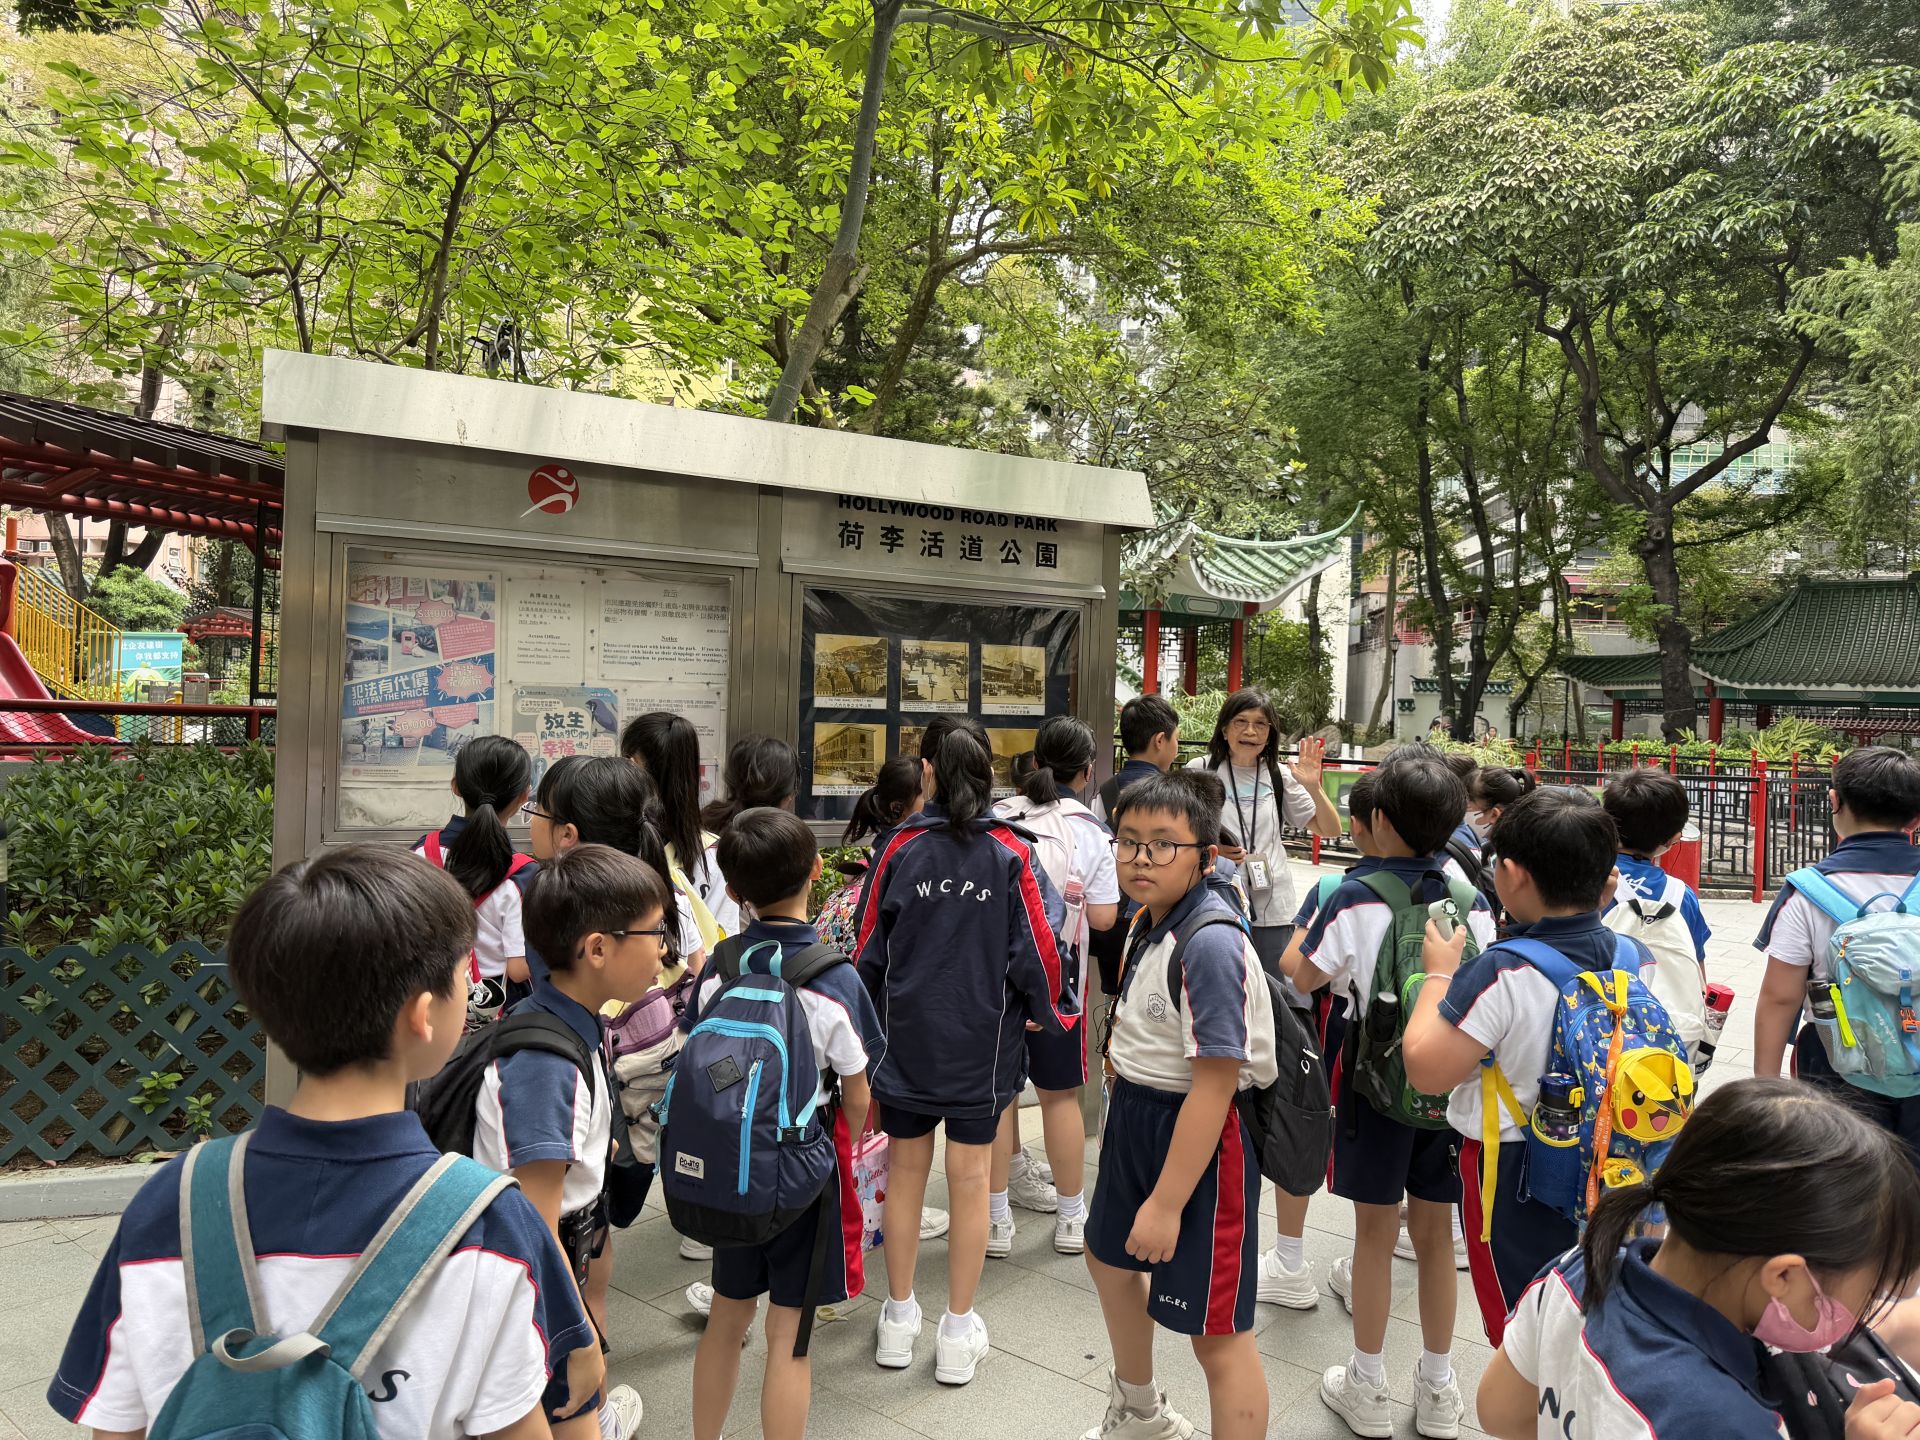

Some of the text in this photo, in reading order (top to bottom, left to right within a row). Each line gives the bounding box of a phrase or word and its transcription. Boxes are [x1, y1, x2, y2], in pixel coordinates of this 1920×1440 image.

[838, 494, 1058, 533] HOLLYWOOD ROAD PARK
[838, 520, 1058, 569] 荷李活道公園
[351, 669, 430, 700] 犯法有代價
[352, 697, 370, 706] DON'T
[370, 694, 383, 704] PAY
[384, 692, 400, 702] THE
[400, 686, 430, 699] PRICE
[543, 711, 585, 730] 放生
